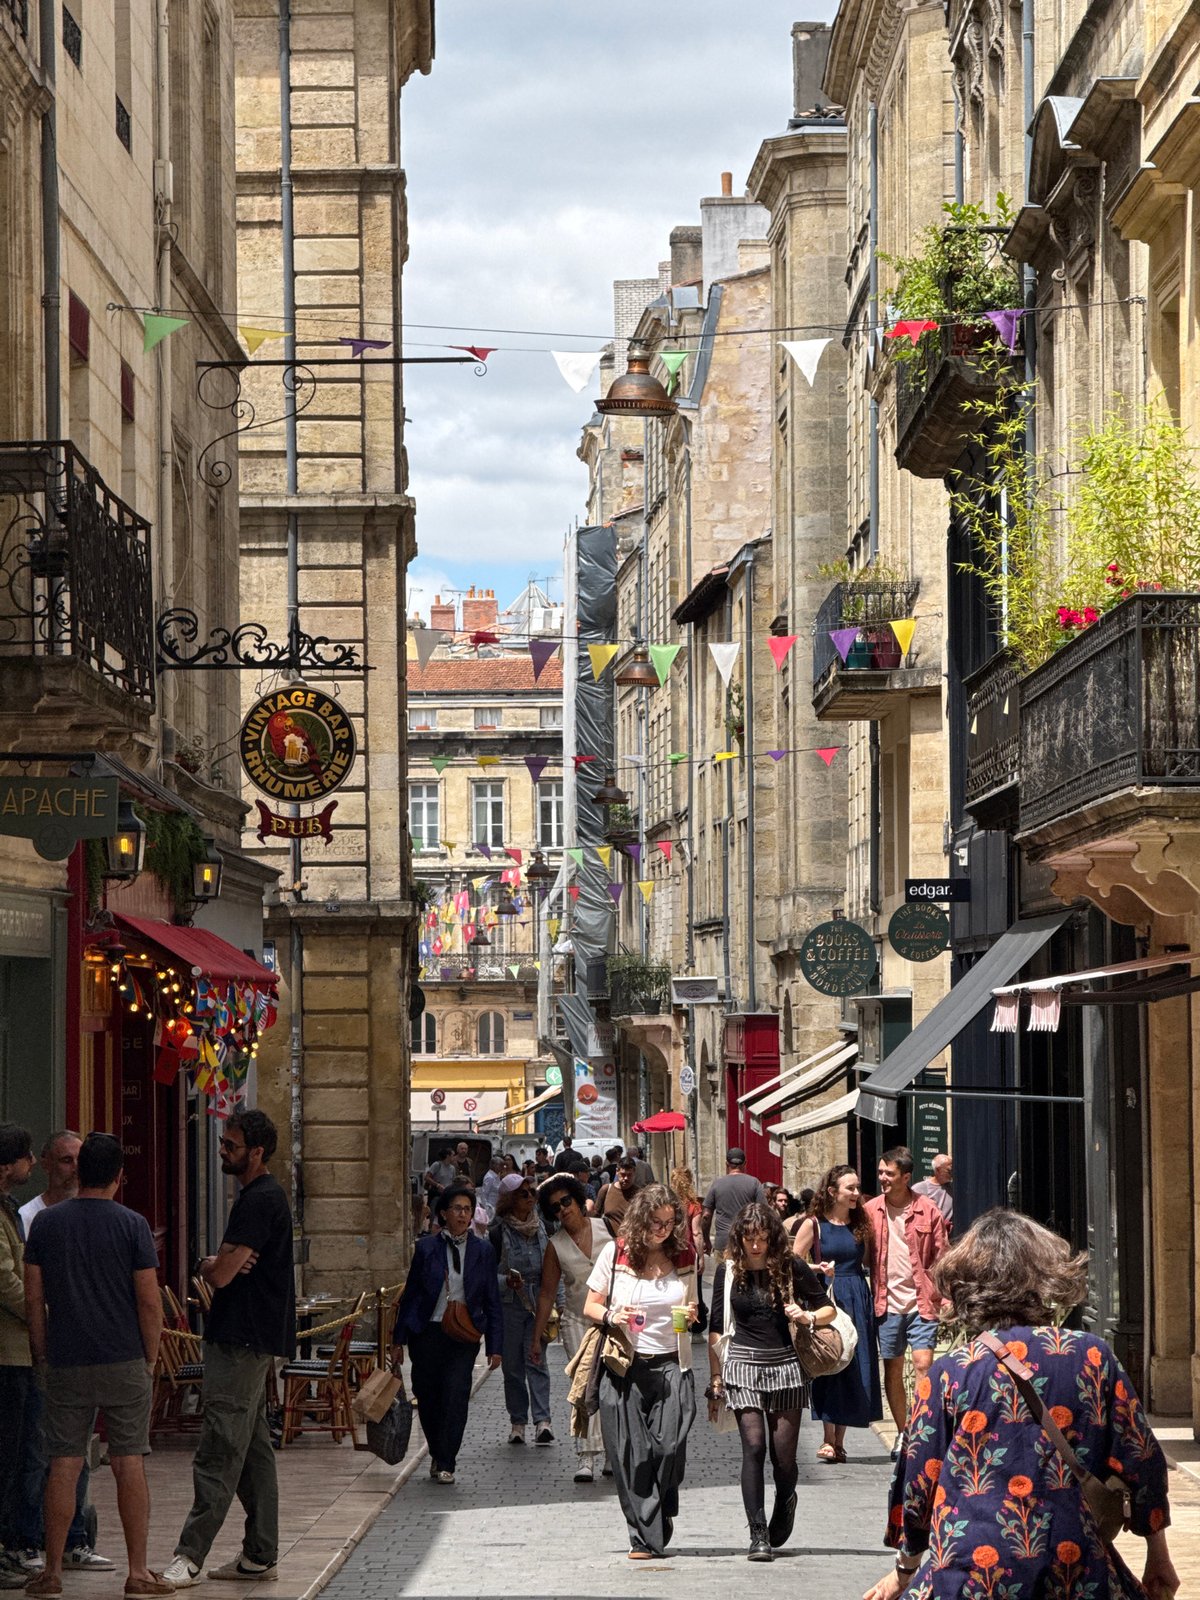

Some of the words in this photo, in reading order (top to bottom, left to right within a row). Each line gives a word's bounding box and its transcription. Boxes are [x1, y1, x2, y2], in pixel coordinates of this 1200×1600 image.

[244, 690, 317, 742] VINTAGE
[317, 700, 350, 741] BAR
[244, 750, 350, 798] RHUMERIE
[2, 787, 109, 817] APACHE
[270, 815, 323, 836] PUB
[908, 882, 953, 899] edgar.
[897, 905, 913, 920] THE
[915, 904, 942, 920] BOOKS
[830, 924, 844, 933] THE
[816, 932, 860, 947] BOOKS
[805, 948, 816, 962] &
[818, 947, 870, 961] COFFEE
[910, 944, 940, 960] COFFEE
[809, 970, 869, 993] BORDEAUX
